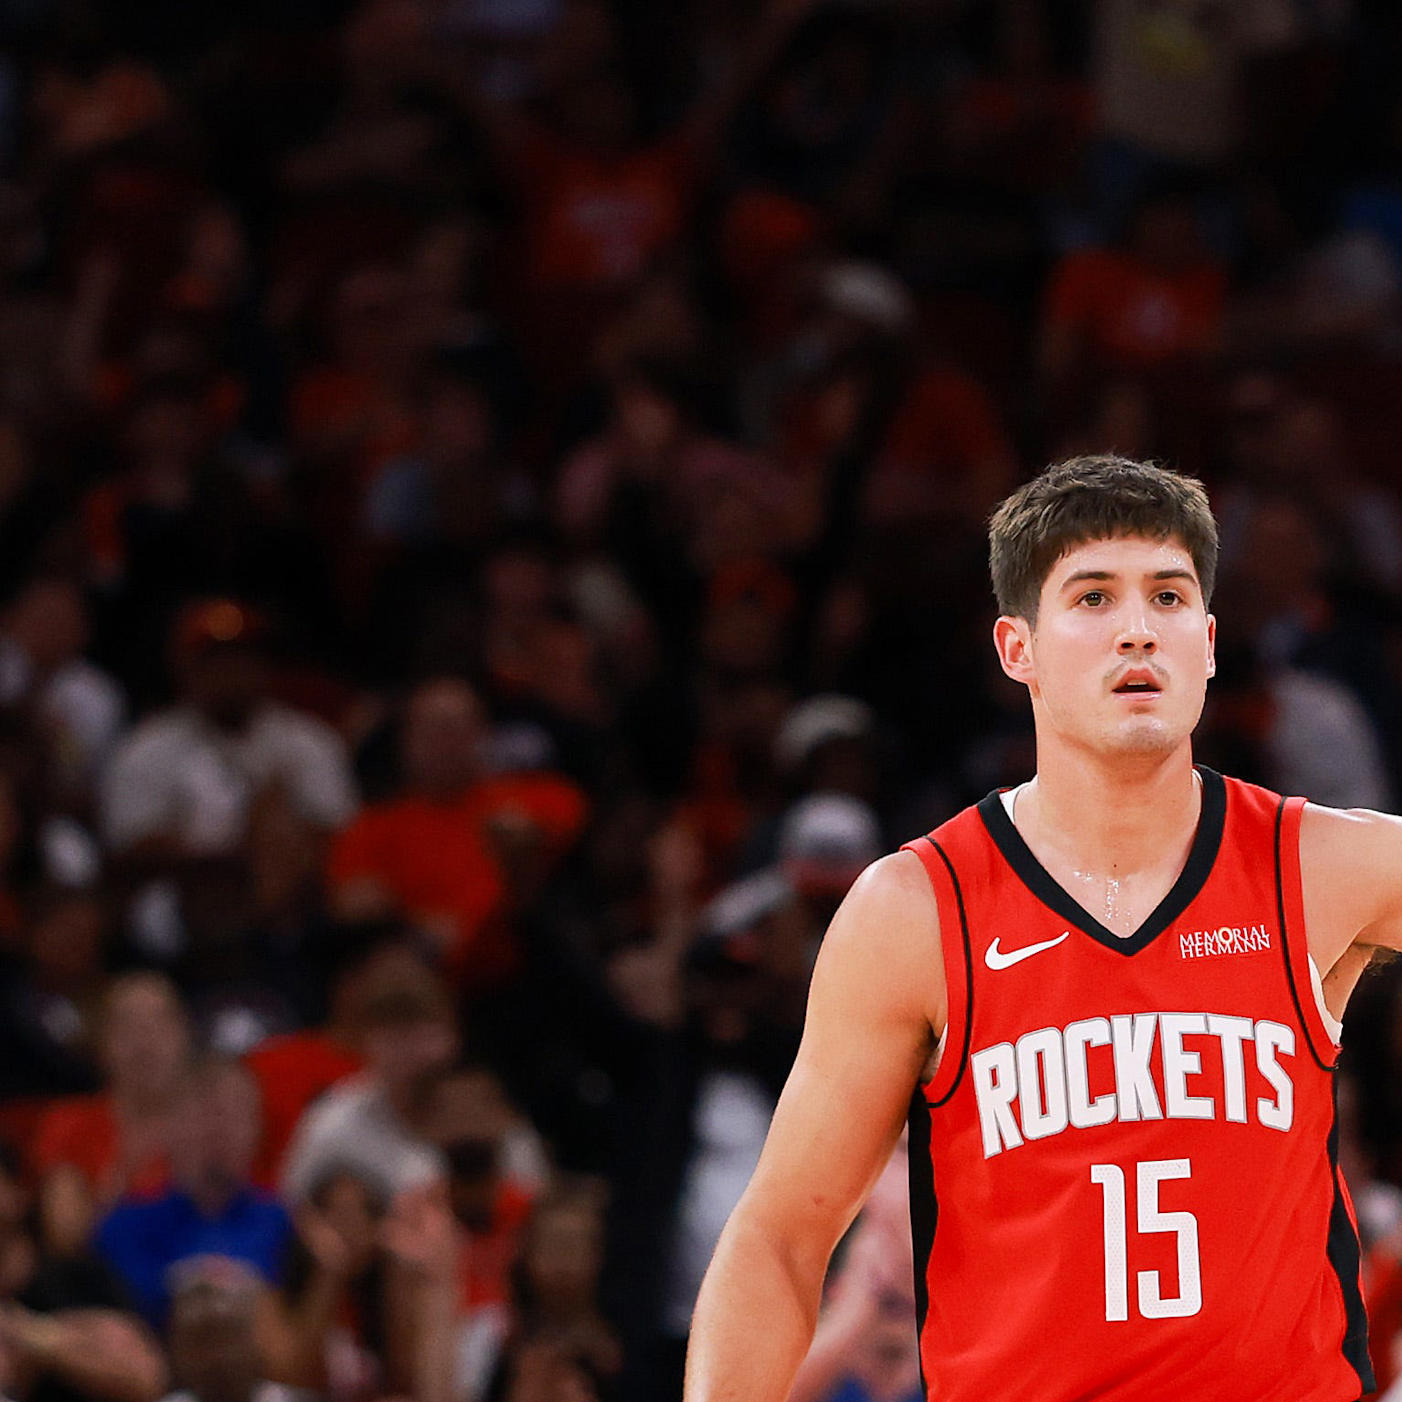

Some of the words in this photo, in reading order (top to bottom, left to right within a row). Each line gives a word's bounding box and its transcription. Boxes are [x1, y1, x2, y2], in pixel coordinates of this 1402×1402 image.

[1180, 924, 1270, 947] MEMORIAL
[1180, 936, 1271, 959] HERMANN
[971, 1012, 1297, 1160] ROCKETS
[1090, 1158, 1203, 1322] 15
